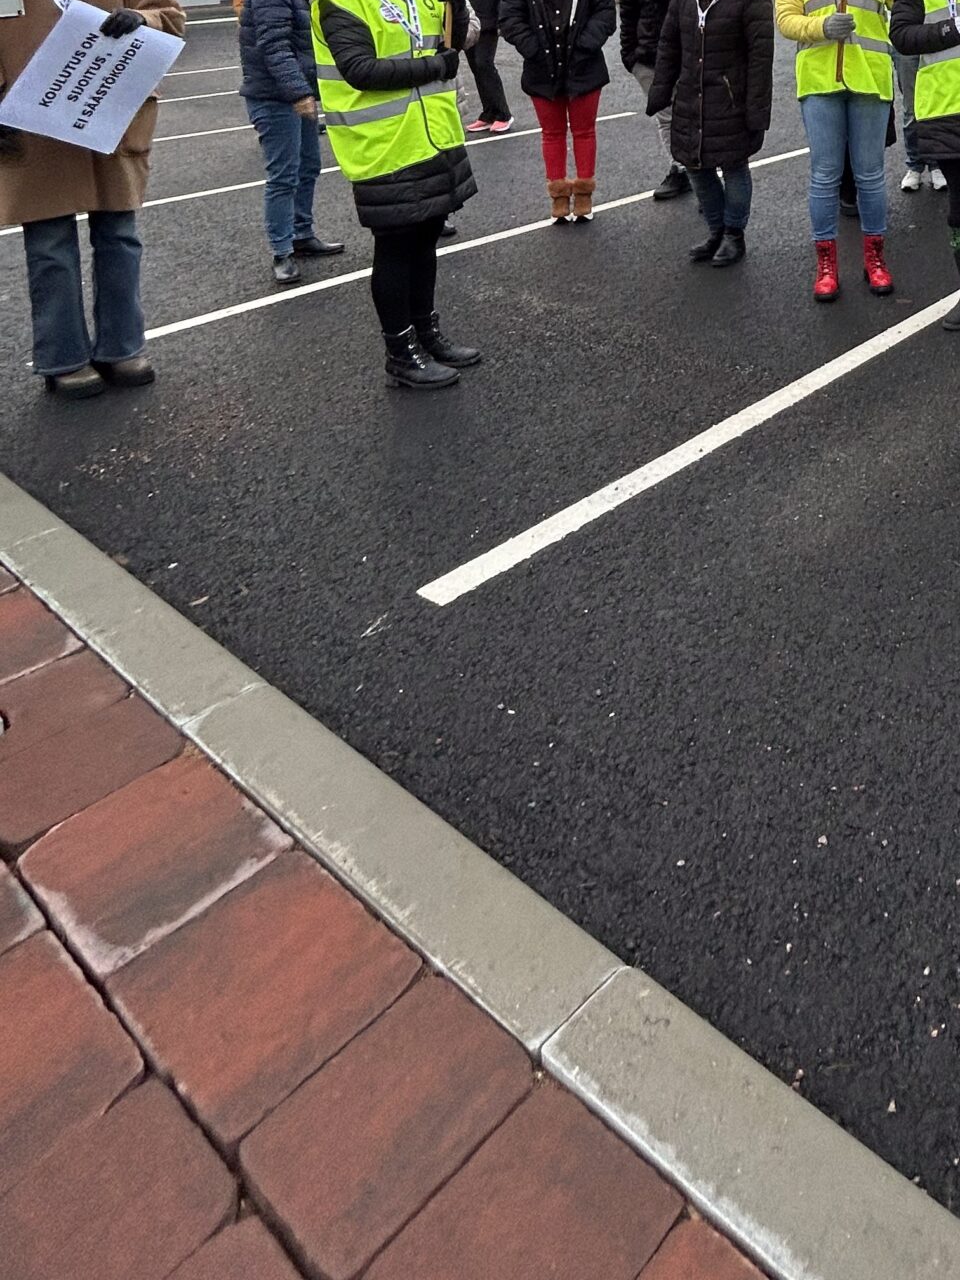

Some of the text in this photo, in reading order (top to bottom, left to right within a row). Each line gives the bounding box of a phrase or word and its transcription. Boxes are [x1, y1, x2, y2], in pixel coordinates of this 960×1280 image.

[39, 50, 87, 108] KOULUTUS
[81, 32, 100, 50] ON
[73, 38, 144, 130] EI SÄÄSTÖKOHDE!
